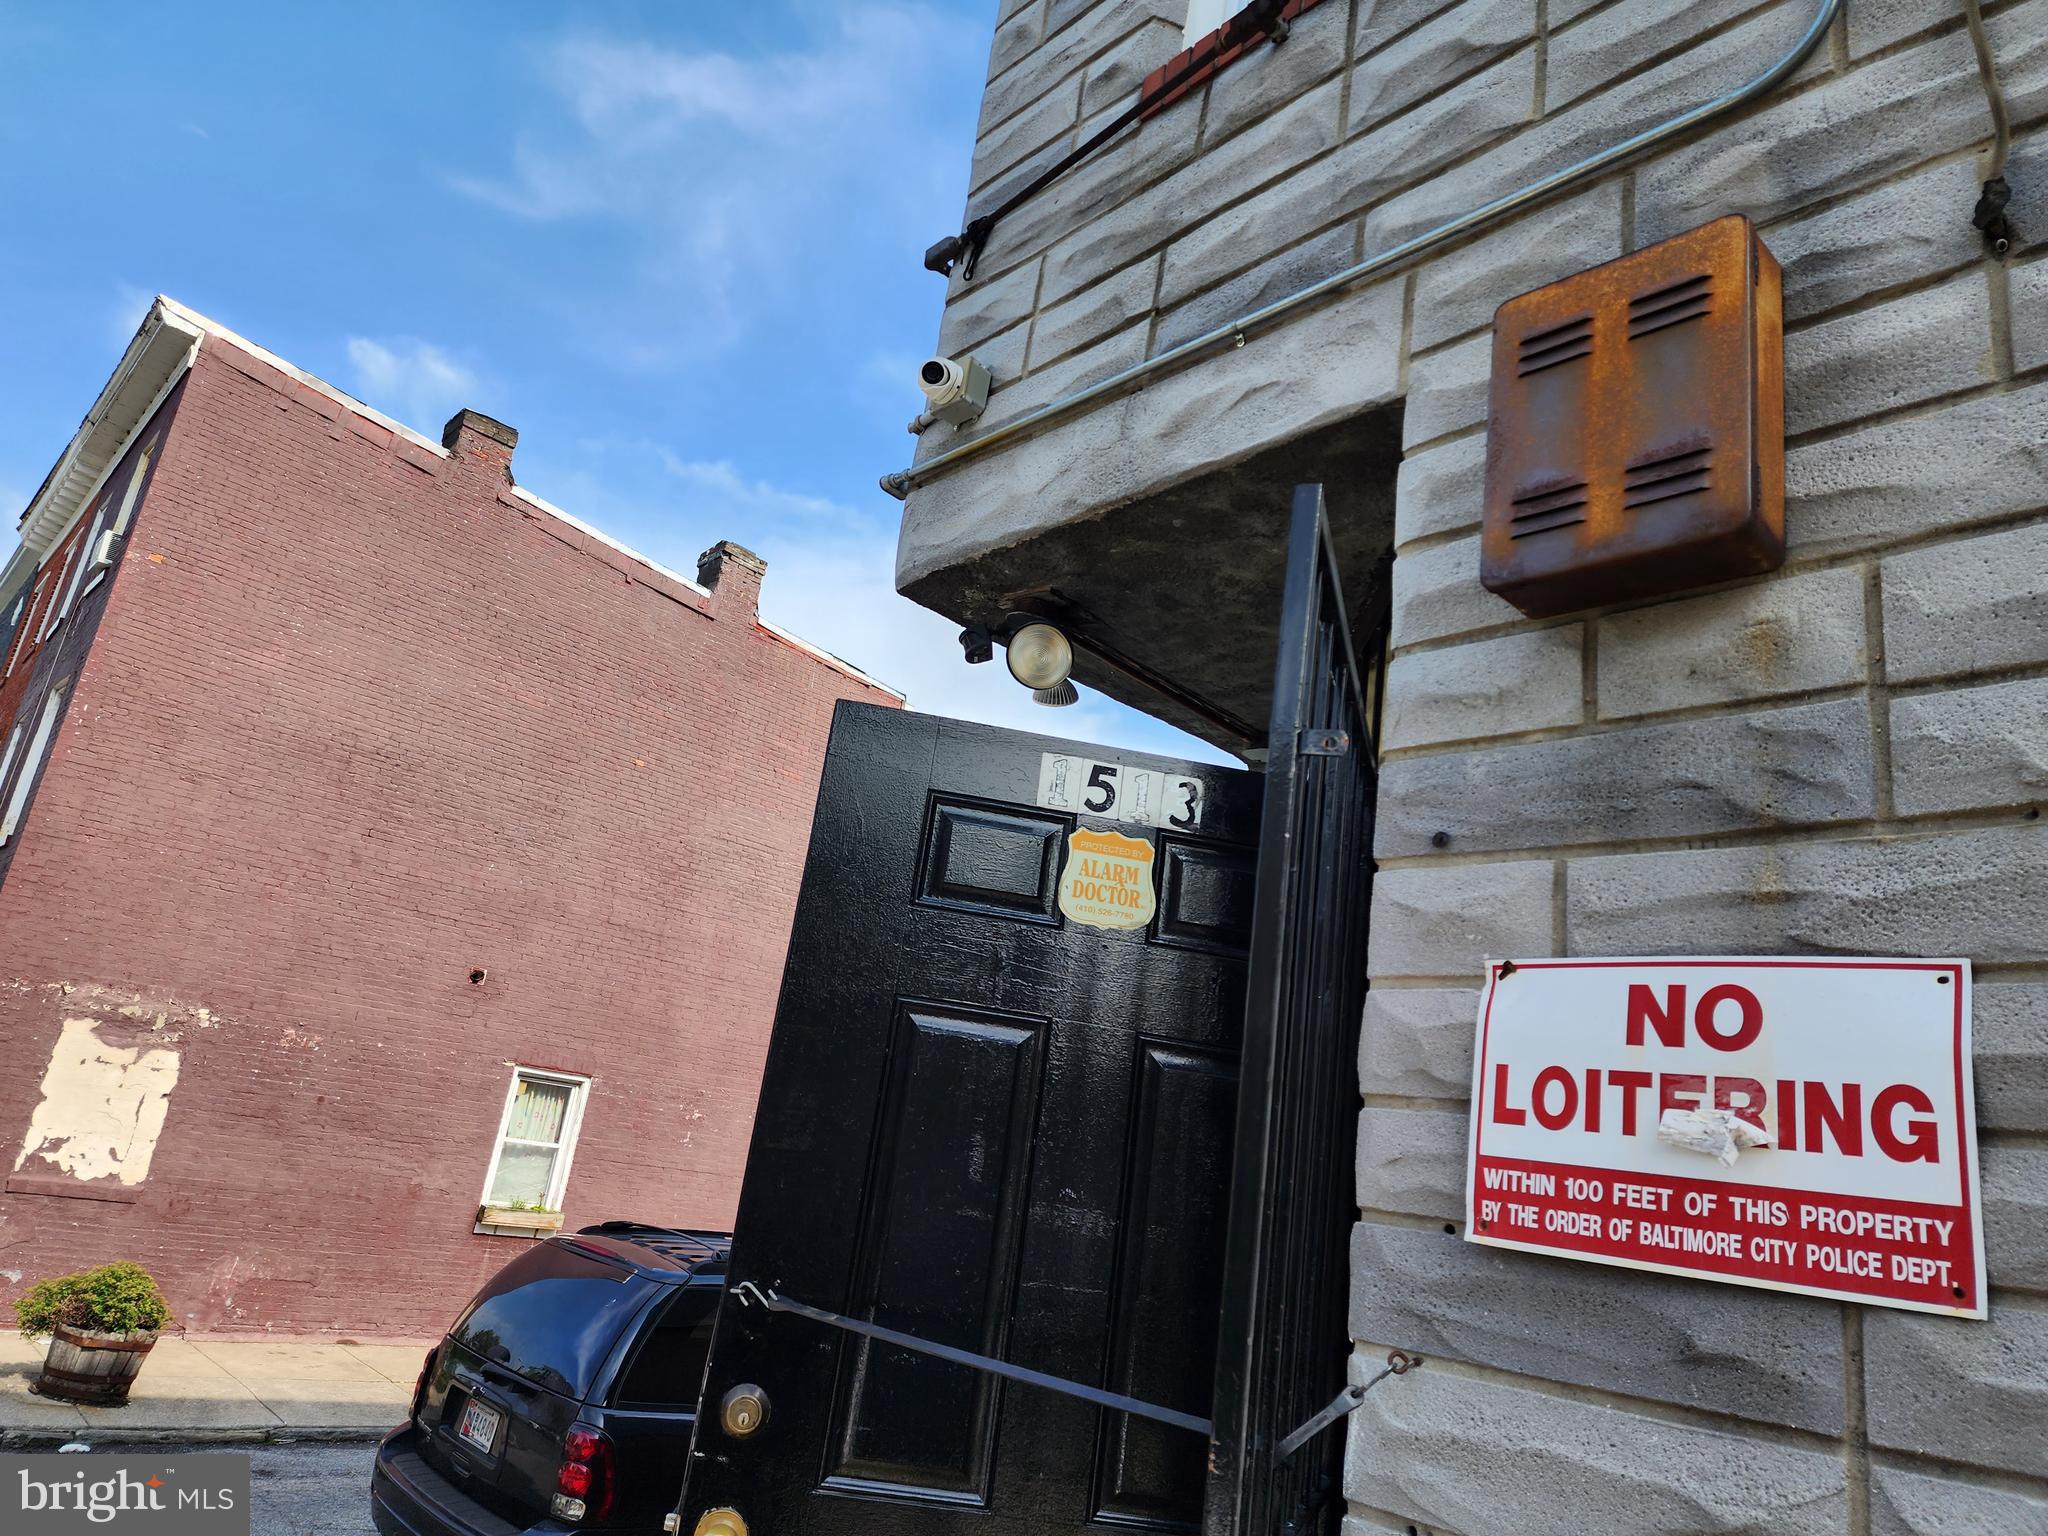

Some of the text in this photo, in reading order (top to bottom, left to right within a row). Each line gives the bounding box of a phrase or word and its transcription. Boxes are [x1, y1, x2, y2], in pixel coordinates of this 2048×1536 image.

[1048, 758, 1199, 828] 1513
[1078, 858, 1141, 887] ALARM
[1079, 840, 1145, 858] PROTECTED BY
[1071, 879, 1142, 909] DOCTOR
[1625, 984, 1764, 1052] NO
[1483, 1167, 1954, 1247] WITHIN 100 FEET OF THIS PROPERTY
[1481, 1200, 1959, 1289] BY THE ORDER OF BALTIMORE CITY POLICE DEPT.
